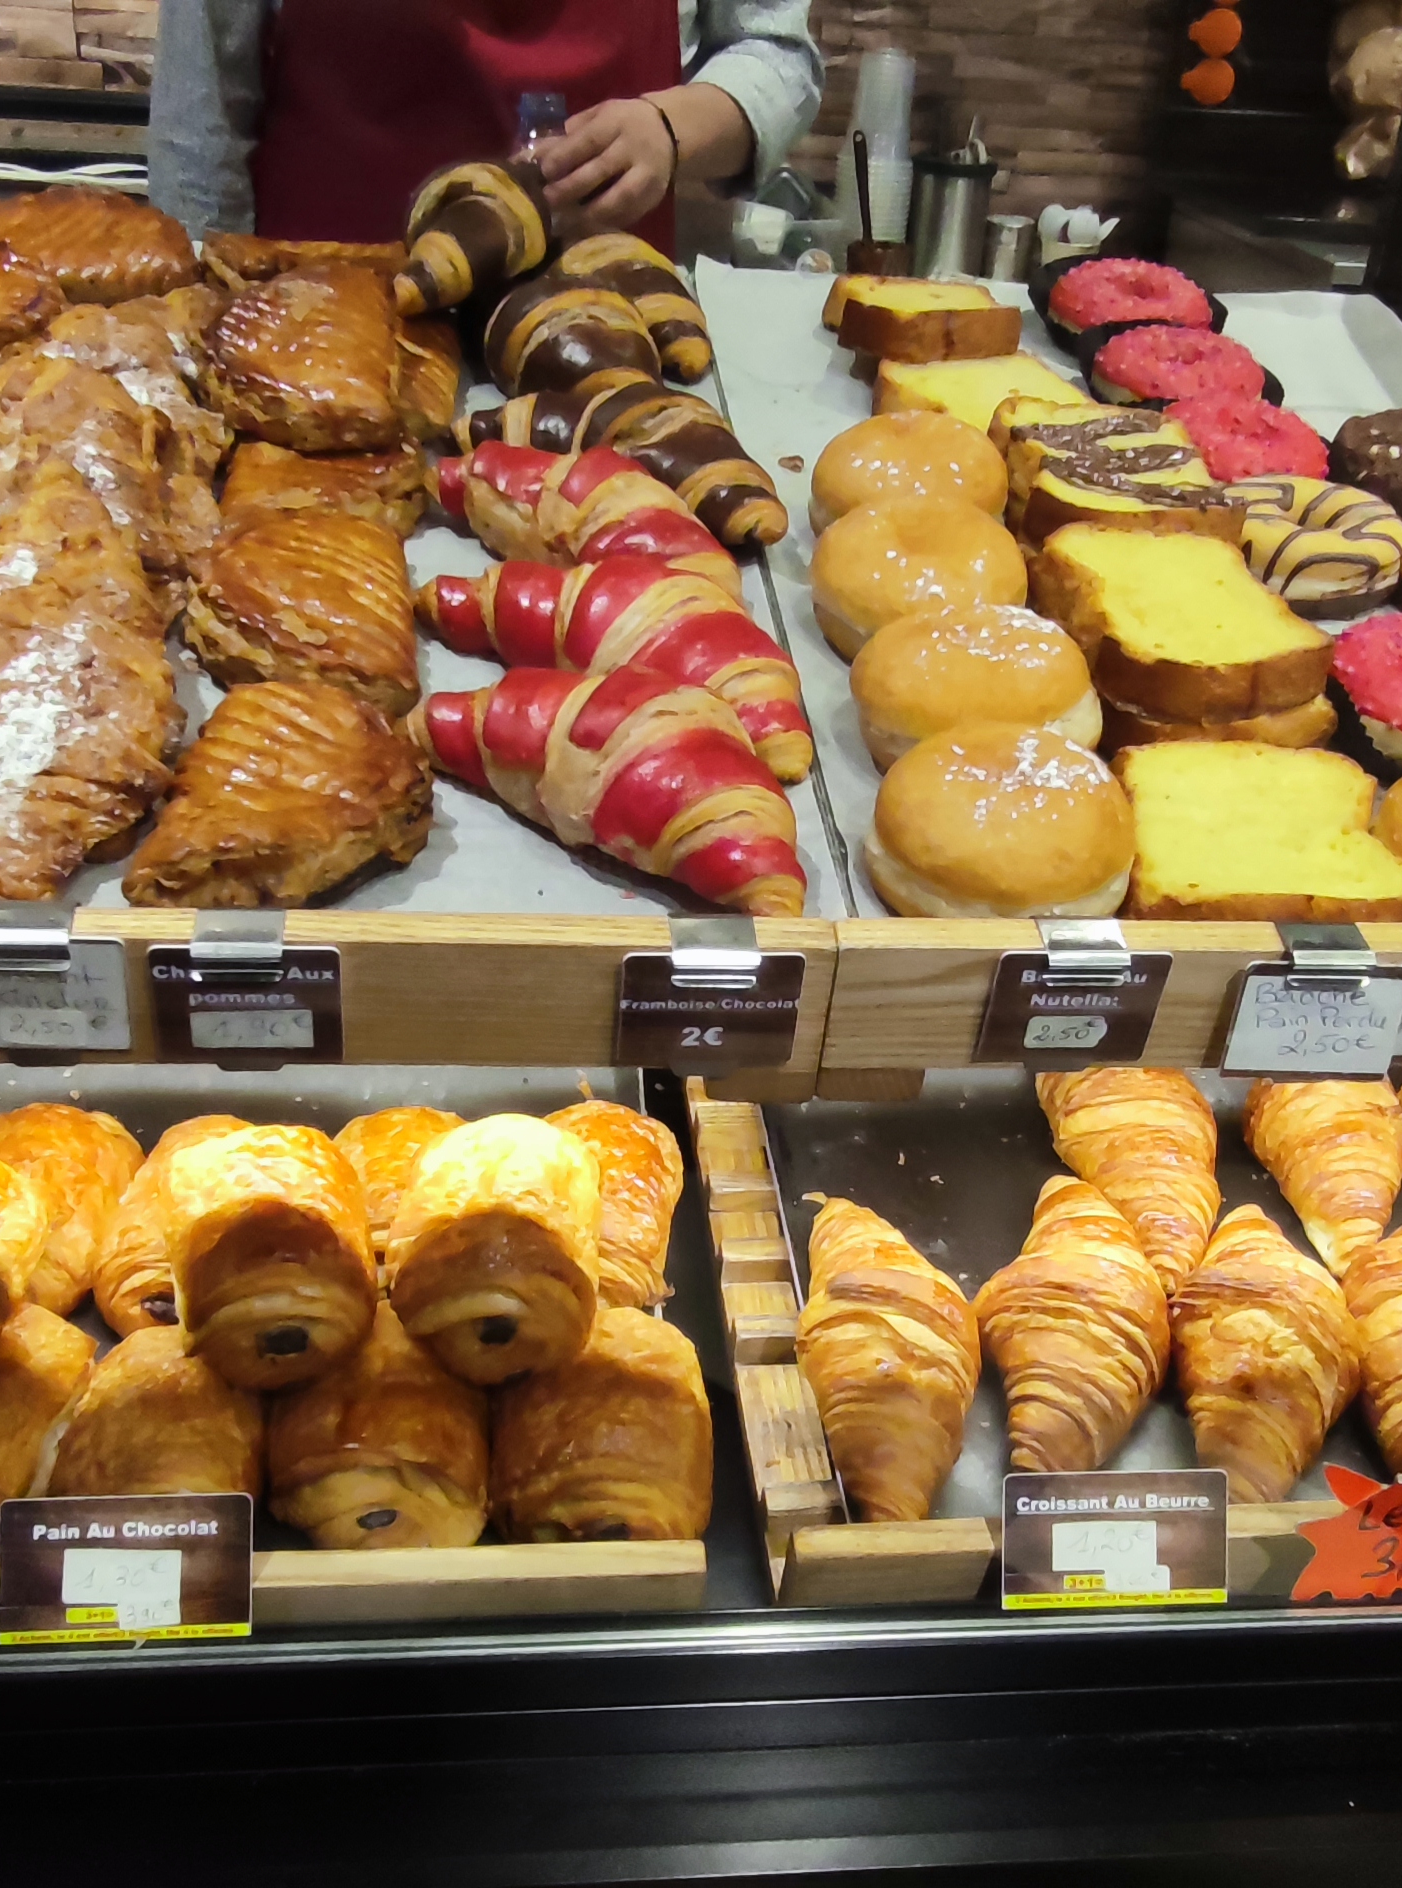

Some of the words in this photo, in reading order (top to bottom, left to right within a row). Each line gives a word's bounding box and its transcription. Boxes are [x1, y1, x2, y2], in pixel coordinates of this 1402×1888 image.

[286, 966, 335, 980] Aux
[189, 993, 296, 1007] pommes
[1030, 993, 1120, 1008] Nutella:
[1256, 1007, 1309, 1029] Pain
[680, 1026, 725, 1047] 2€
[1016, 1496, 1109, 1512] Croissant
[1113, 1494, 1140, 1510] Au
[1145, 1493, 1210, 1509] Beurre
[32, 1524, 80, 1540] Pain
[86, 1522, 116, 1538] Au
[122, 1519, 219, 1538] Chocolat
